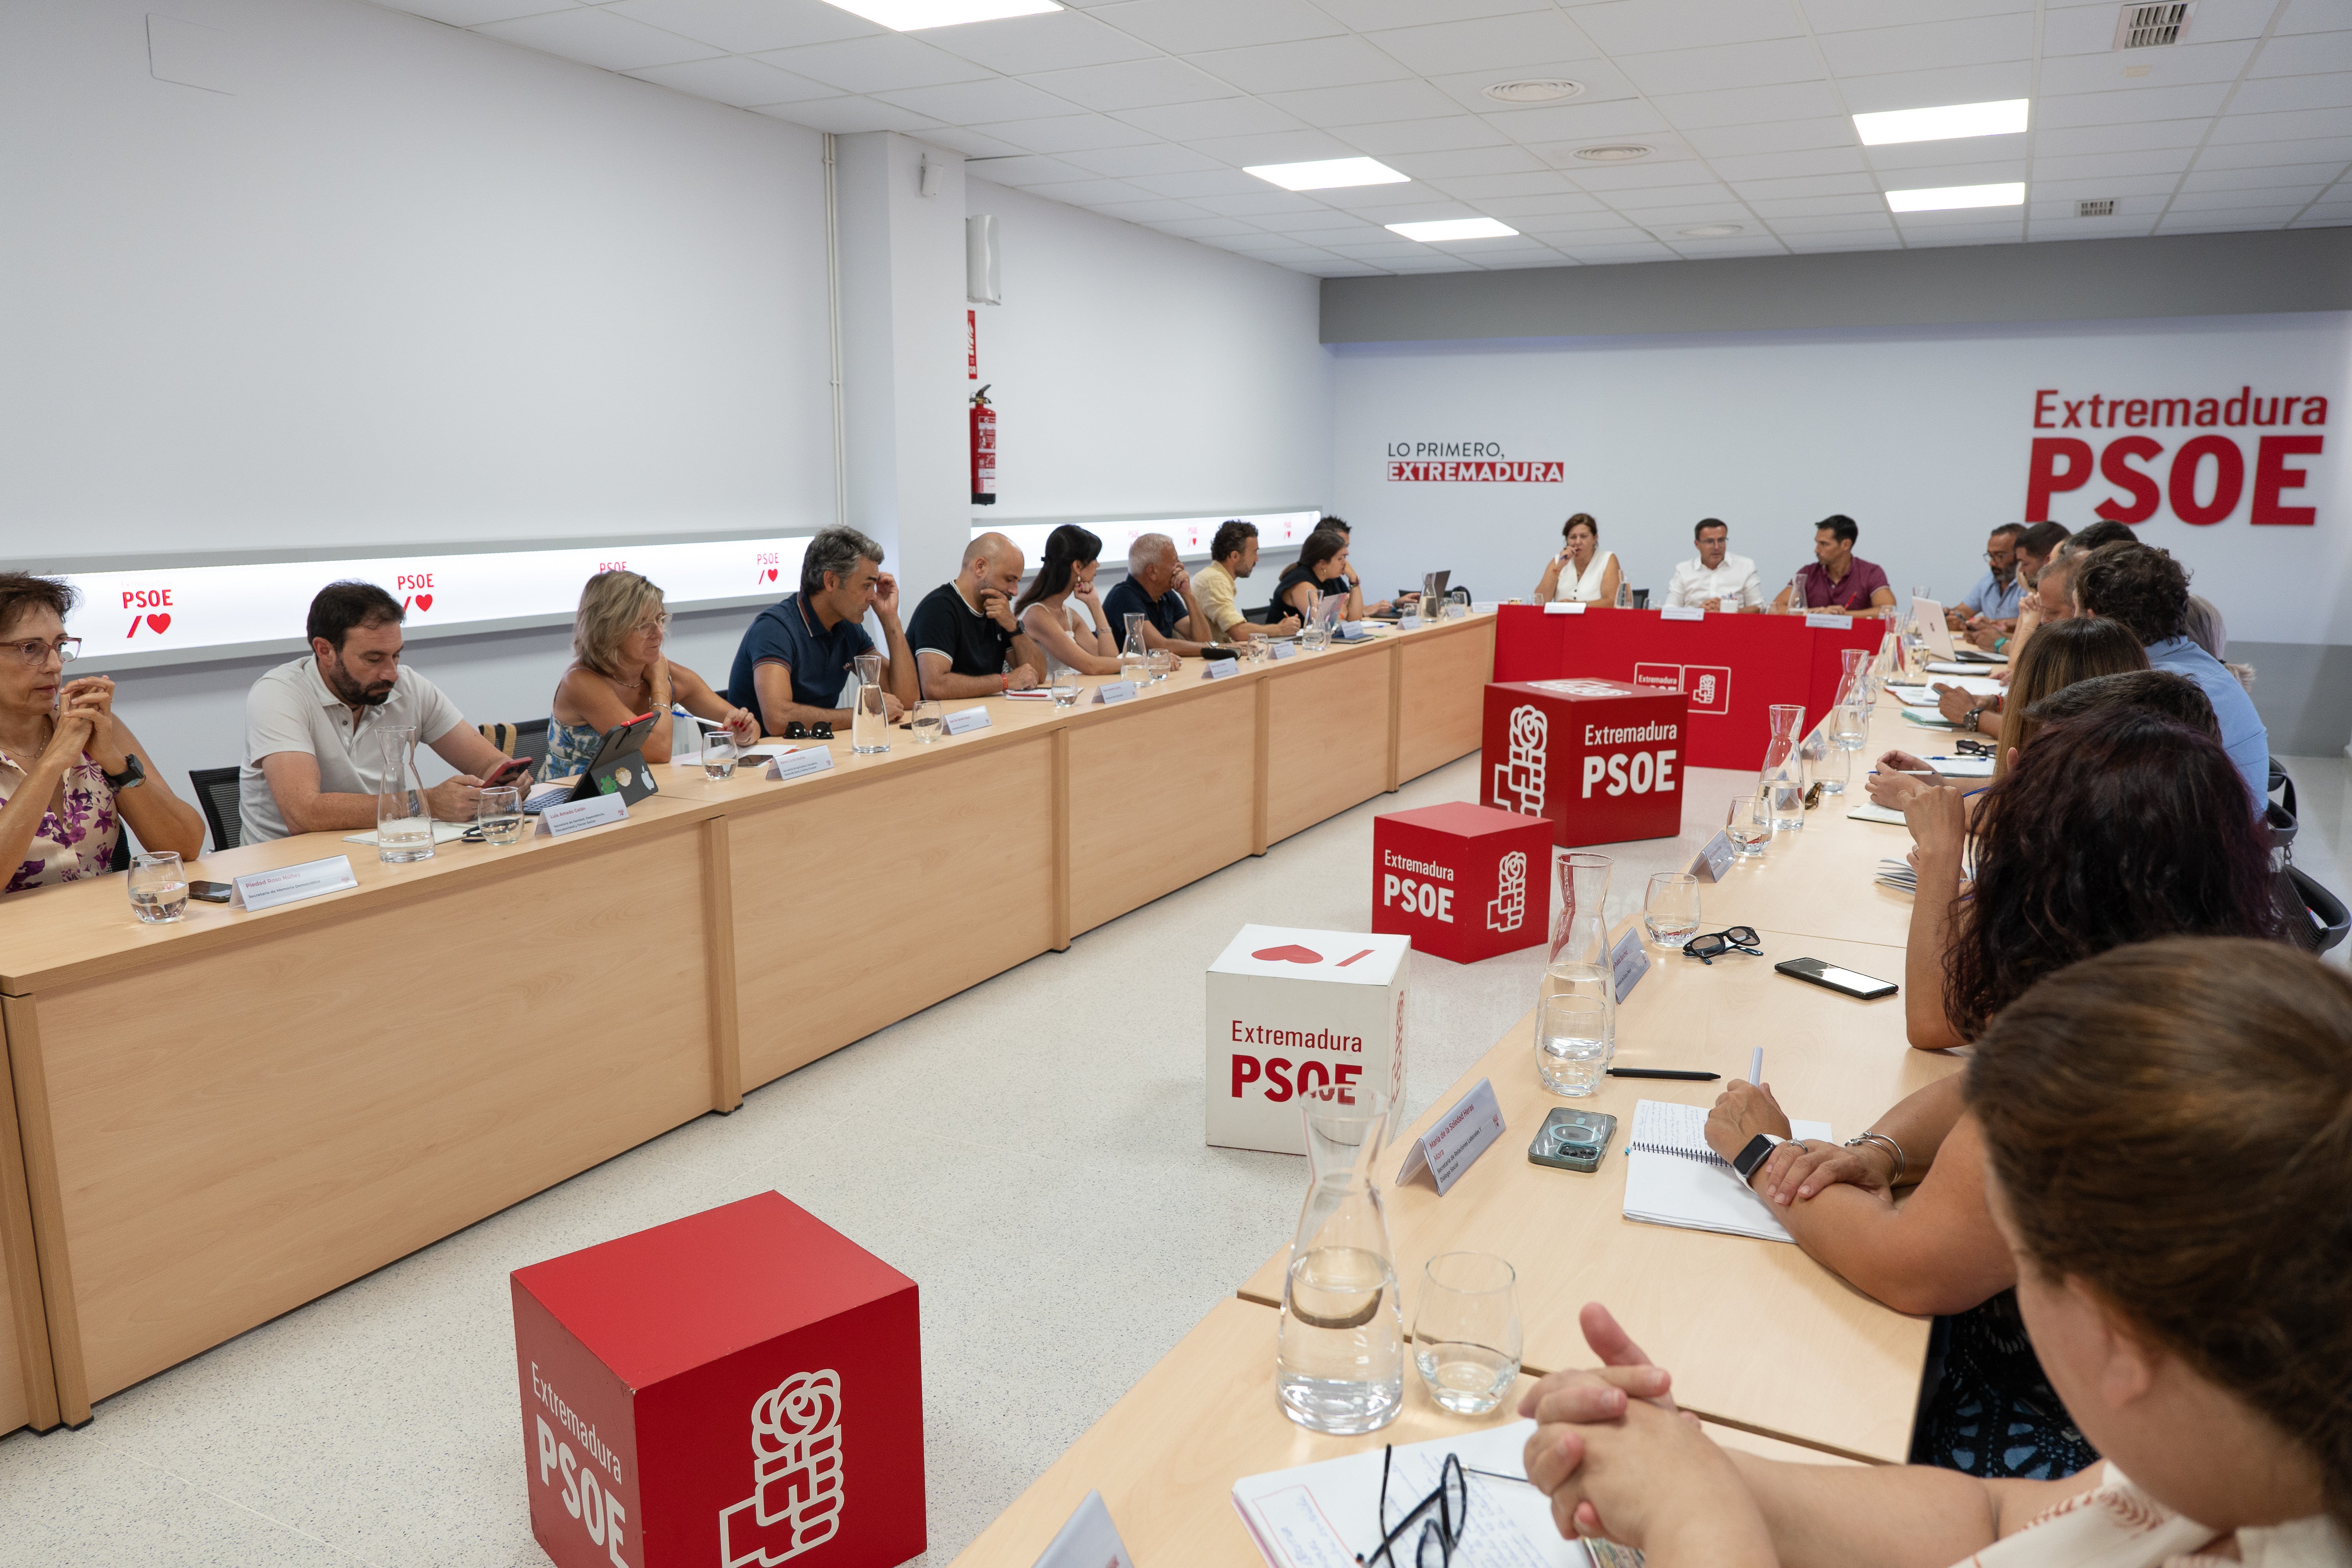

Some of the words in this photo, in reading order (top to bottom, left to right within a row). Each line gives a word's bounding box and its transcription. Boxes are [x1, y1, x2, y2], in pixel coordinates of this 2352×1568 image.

[2034, 386, 2328, 428] Extremadura
[1388, 443, 1410, 457] LO
[1417, 443, 1505, 459] PRIMERO,
[1388, 463, 1563, 481] EXTREMADURA
[2025, 435, 2324, 526] PSOE
[757, 553, 779, 565] PSOE
[397, 573, 434, 590] PSOE
[122, 589, 173, 609] PSOE
[1638, 674, 1677, 685] Extremadura
[1585, 720, 1677, 746] Extremadura
[1582, 750, 1677, 798] PSOE
[1385, 849, 1454, 882] Extremadura
[1384, 874, 1454, 924] PSOE
[1232, 1020, 1362, 1053] Extremadura
[1232, 1054, 1362, 1105] PSOE
[1429, 1135, 1441, 1150] María
[1441, 1130, 1446, 1138] de
[1449, 1112, 1464, 1131] Soledad
[1463, 1103, 1474, 1118] Heras
[1433, 1149, 1445, 1162] Mora
[1454, 1141, 1468, 1157] Relaciones
[1467, 1130, 1479, 1145] Laborales
[1450, 1161, 1459, 1173] Social
[531, 1360, 622, 1485] Extremadura
[536, 1413, 629, 1568] PSOE
